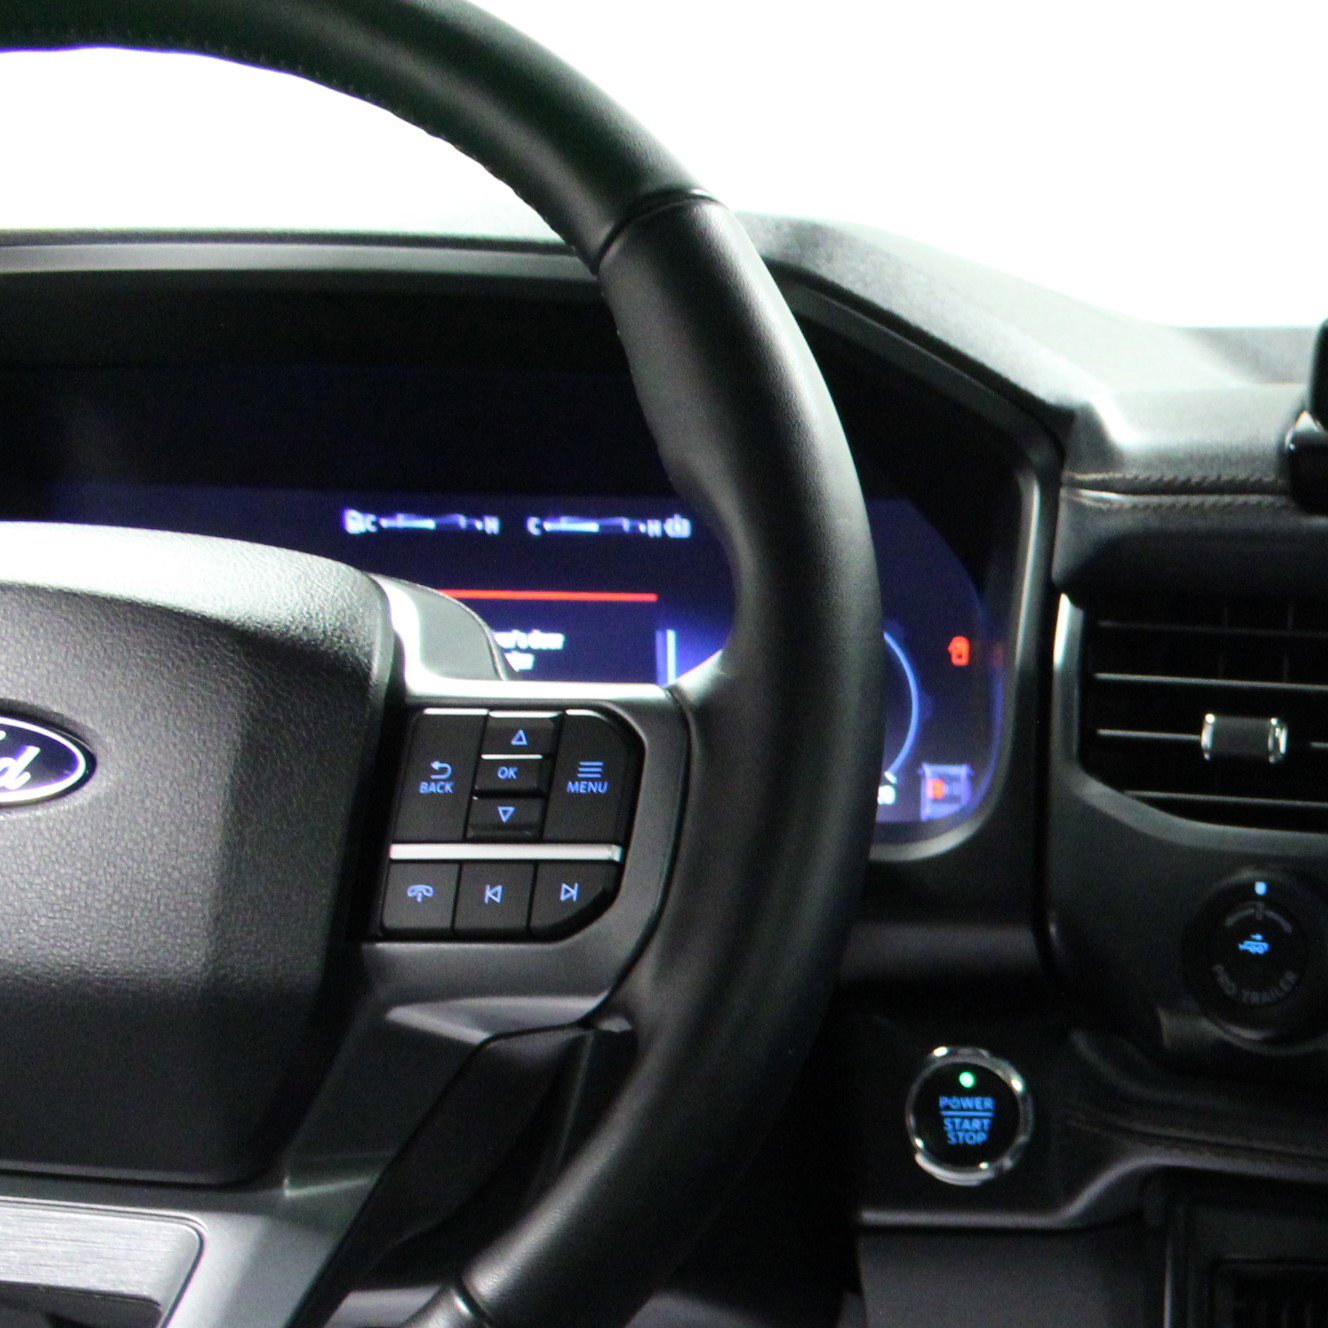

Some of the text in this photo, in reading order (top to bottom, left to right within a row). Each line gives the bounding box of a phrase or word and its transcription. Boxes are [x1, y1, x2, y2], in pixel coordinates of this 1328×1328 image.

[497, 766, 518, 780] OK
[419, 777, 454, 795] BACK
[566, 780, 608, 794] MENU
[939, 1096, 995, 1111] POWER
[944, 1117, 991, 1132] START
[947, 1131, 988, 1145] STOP
